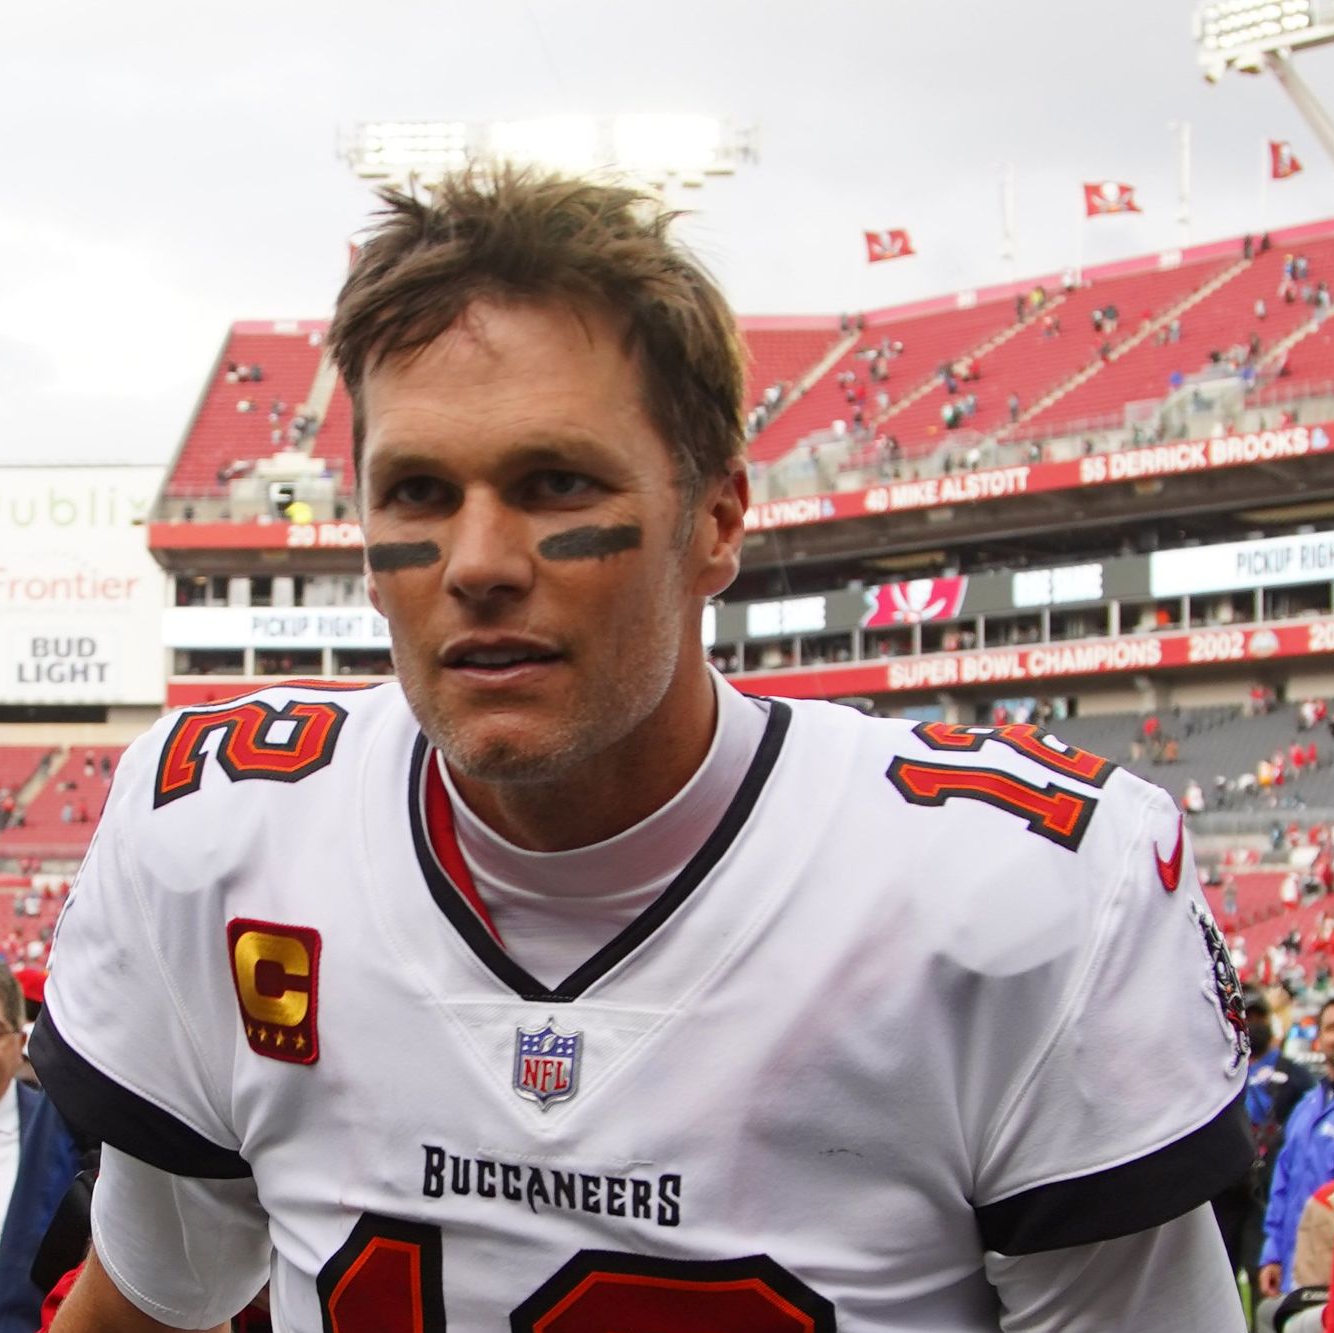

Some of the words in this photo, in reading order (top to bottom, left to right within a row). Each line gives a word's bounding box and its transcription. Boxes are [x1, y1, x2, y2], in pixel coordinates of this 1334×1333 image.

[1079, 455, 1107, 483] 55
[1108, 441, 1207, 479] DERRICK
[1208, 426, 1310, 466] BROOKS
[865, 486, 890, 513] 40
[891, 479, 938, 511] MIKE
[939, 466, 1030, 501] ALSTOTT
[762, 497, 822, 528] LYNCH
[1236, 546, 1293, 578] PICKUP
[31, 637, 97, 668] BUD
[888, 656, 961, 691] SUPER
[961, 649, 1026, 685] BOWL
[1026, 638, 1163, 677] CHAMPIONS
[1187, 631, 1245, 662] 2002
[17, 662, 110, 685] LIGHT
[153, 698, 349, 810] 2
[233, 930, 312, 1027] C
[522, 1058, 569, 1093] NFL
[420, 1144, 682, 1228] BUCCANEERS
